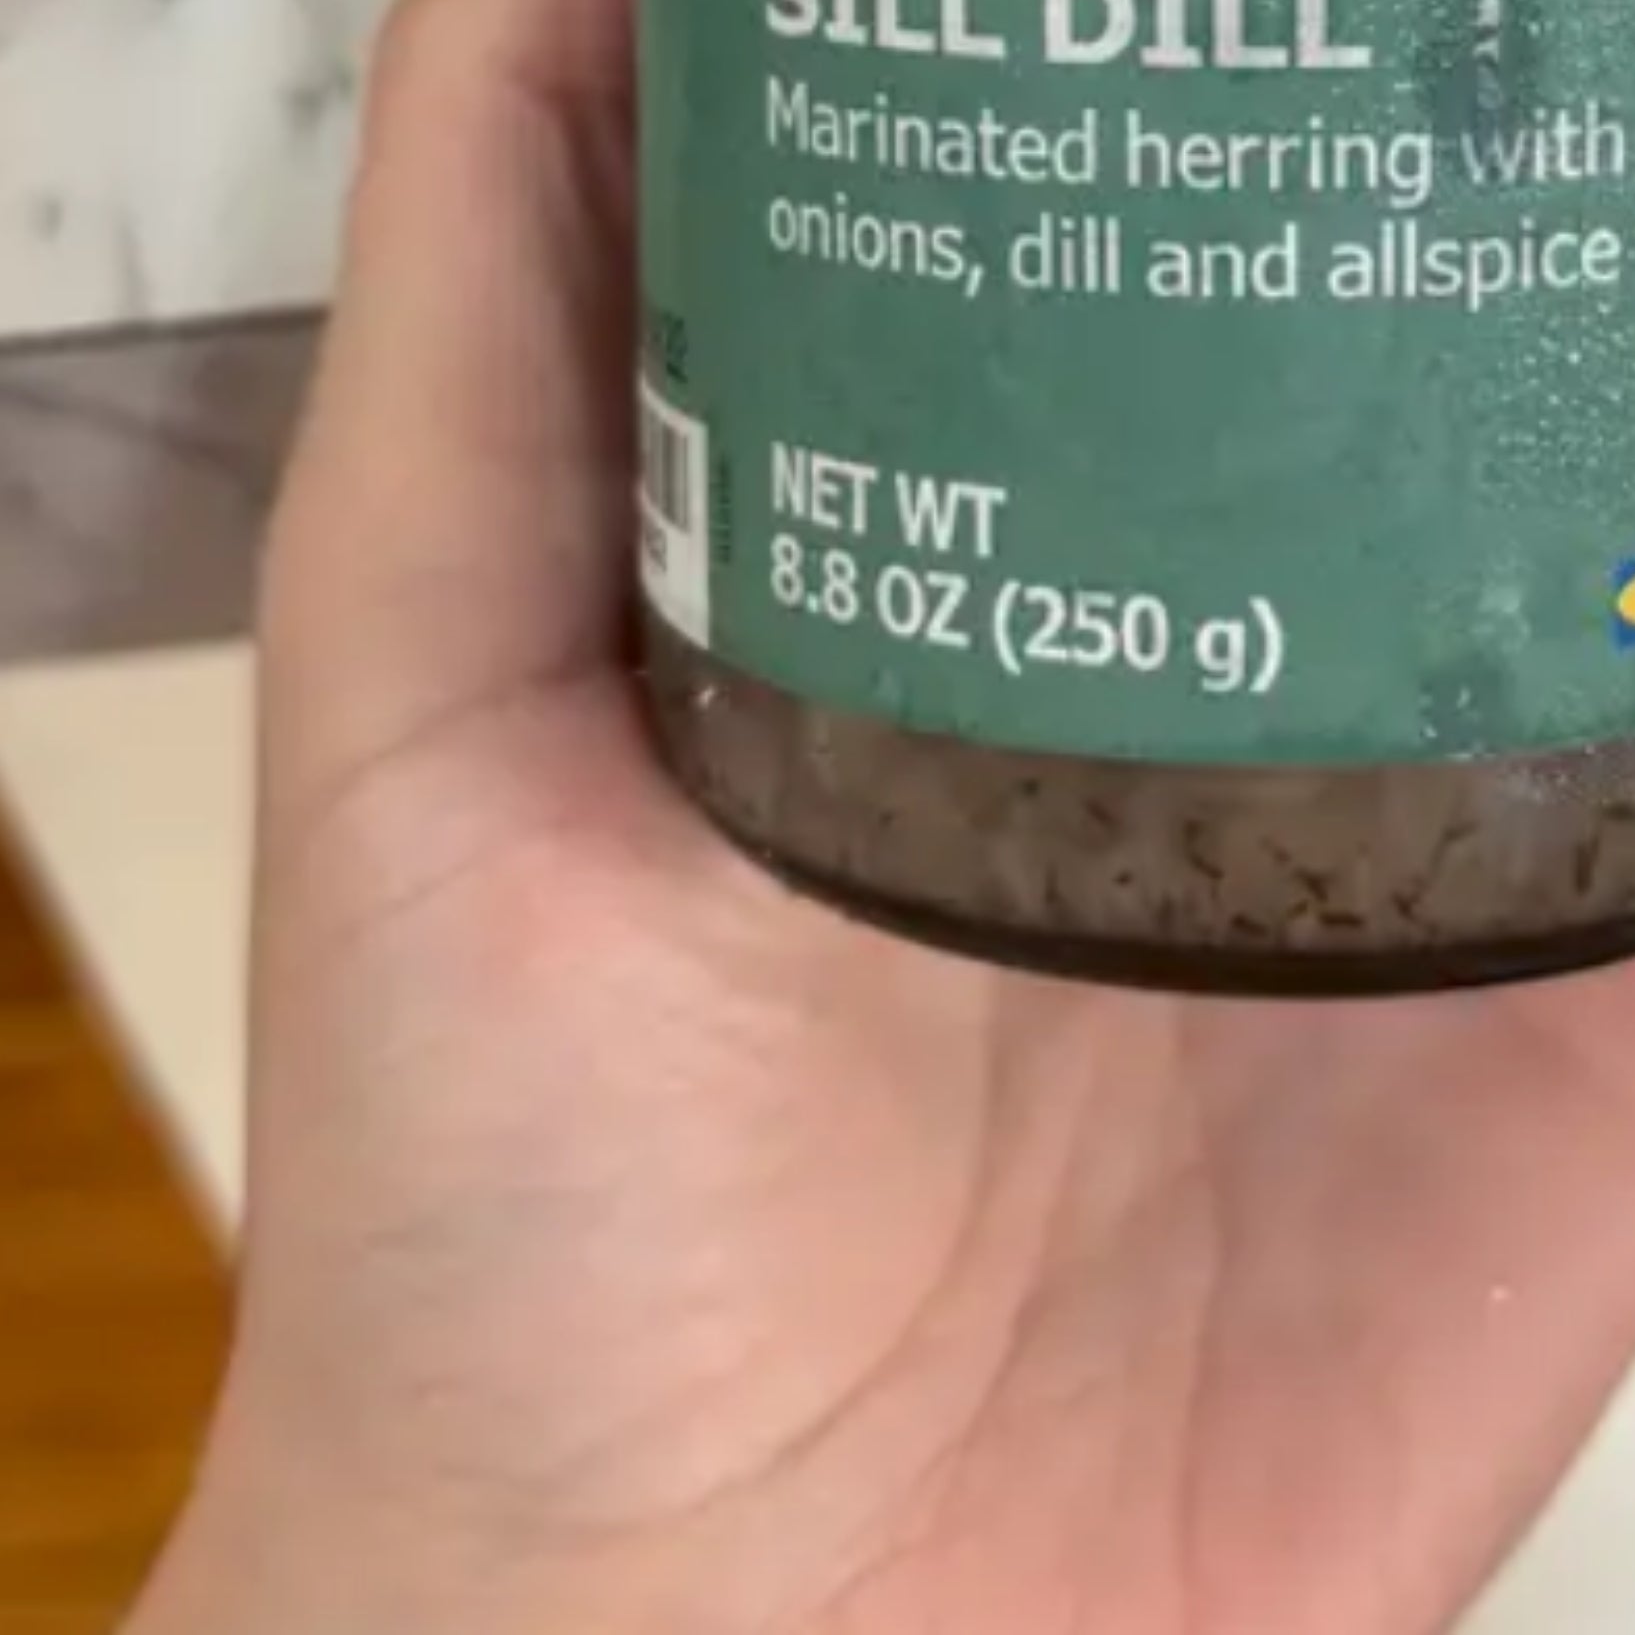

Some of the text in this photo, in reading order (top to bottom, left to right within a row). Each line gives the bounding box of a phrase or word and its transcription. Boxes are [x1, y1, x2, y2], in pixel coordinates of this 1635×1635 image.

[766, 75, 1627, 209] Marinated herring with
[768, 192, 1624, 314] onions, dill and allspice
[770, 440, 879, 536] NET
[895, 470, 1008, 559] WT
[770, 532, 860, 624] 8.8
[875, 565, 972, 651] OZ
[992, 579, 1170, 678] (250
[1194, 595, 1285, 694] g)
